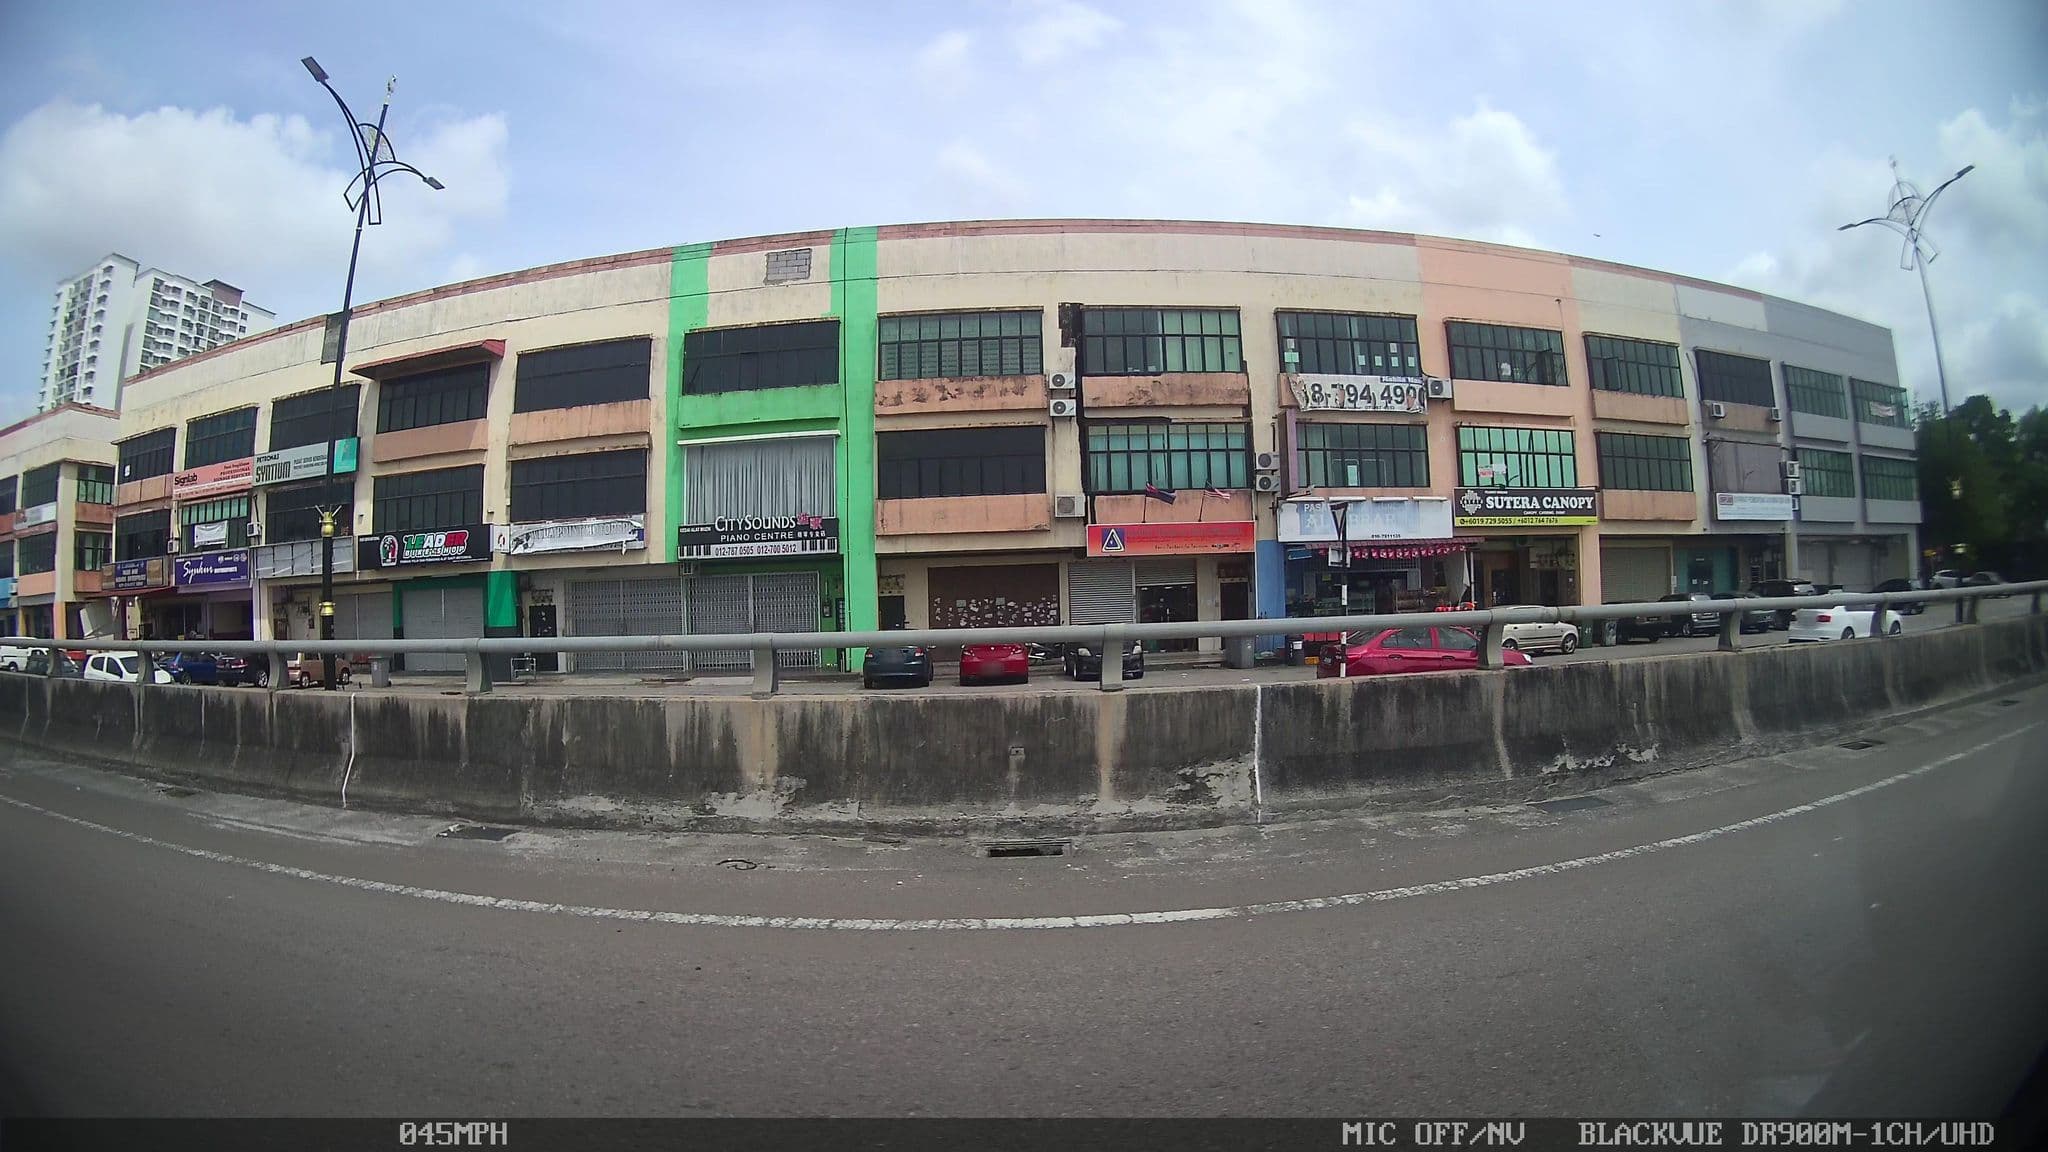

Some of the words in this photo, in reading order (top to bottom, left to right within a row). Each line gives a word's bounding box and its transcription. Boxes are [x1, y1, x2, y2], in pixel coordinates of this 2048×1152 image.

[255, 461, 291, 482] SYNTIUM
[1486, 496, 1540, 509] SUTERA
[1542, 496, 1594, 509] CANOPY
[404, 530, 468, 549] LEADER
[720, 533, 750, 543] PIANO
[754, 530, 794, 541] CENTRE
[782, 543, 797, 553] 5012
